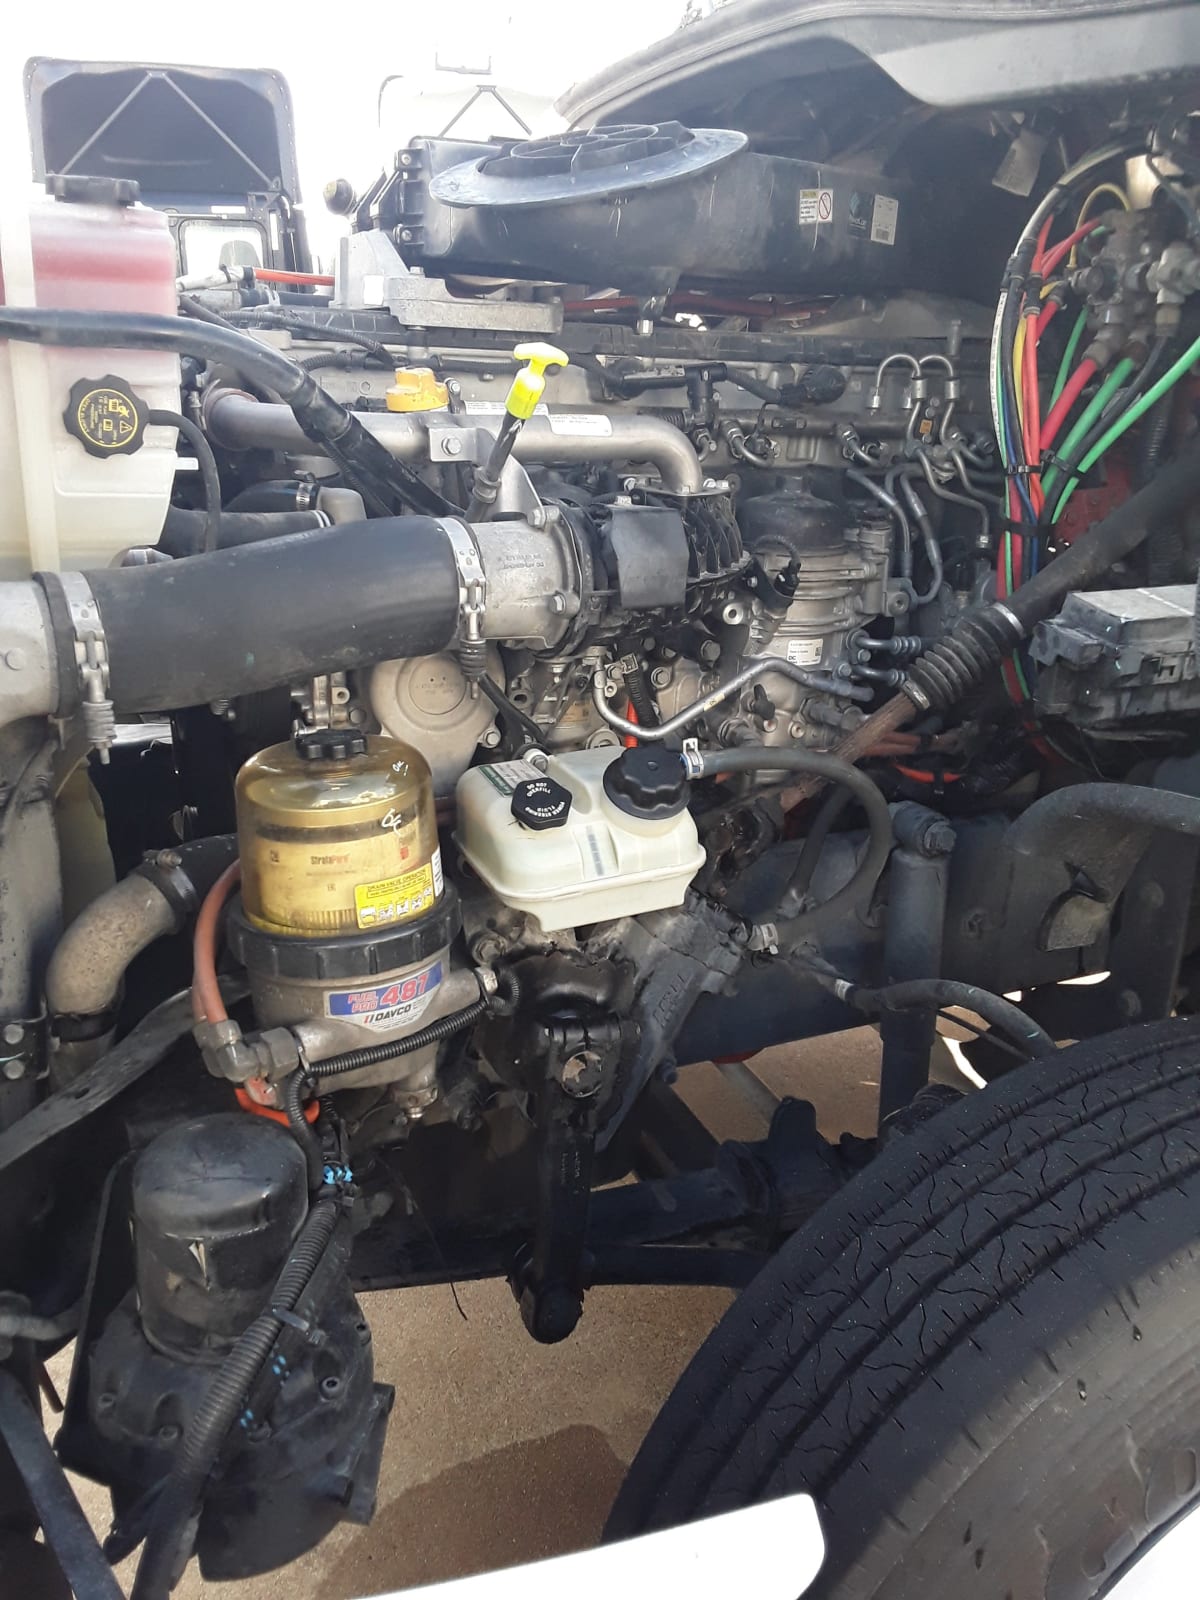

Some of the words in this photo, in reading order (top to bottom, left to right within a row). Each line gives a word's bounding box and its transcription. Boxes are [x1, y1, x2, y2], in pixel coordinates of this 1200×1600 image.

[526, 787, 551, 797] OVERFILL
[524, 806, 552, 818] STEERING
[551, 801, 565, 816] POWER
[348, 991, 378, 1004] FUEL
[380, 972, 429, 1006] 487
[351, 1001, 378, 1014] PRO
[375, 1004, 412, 1021] DAVCO
